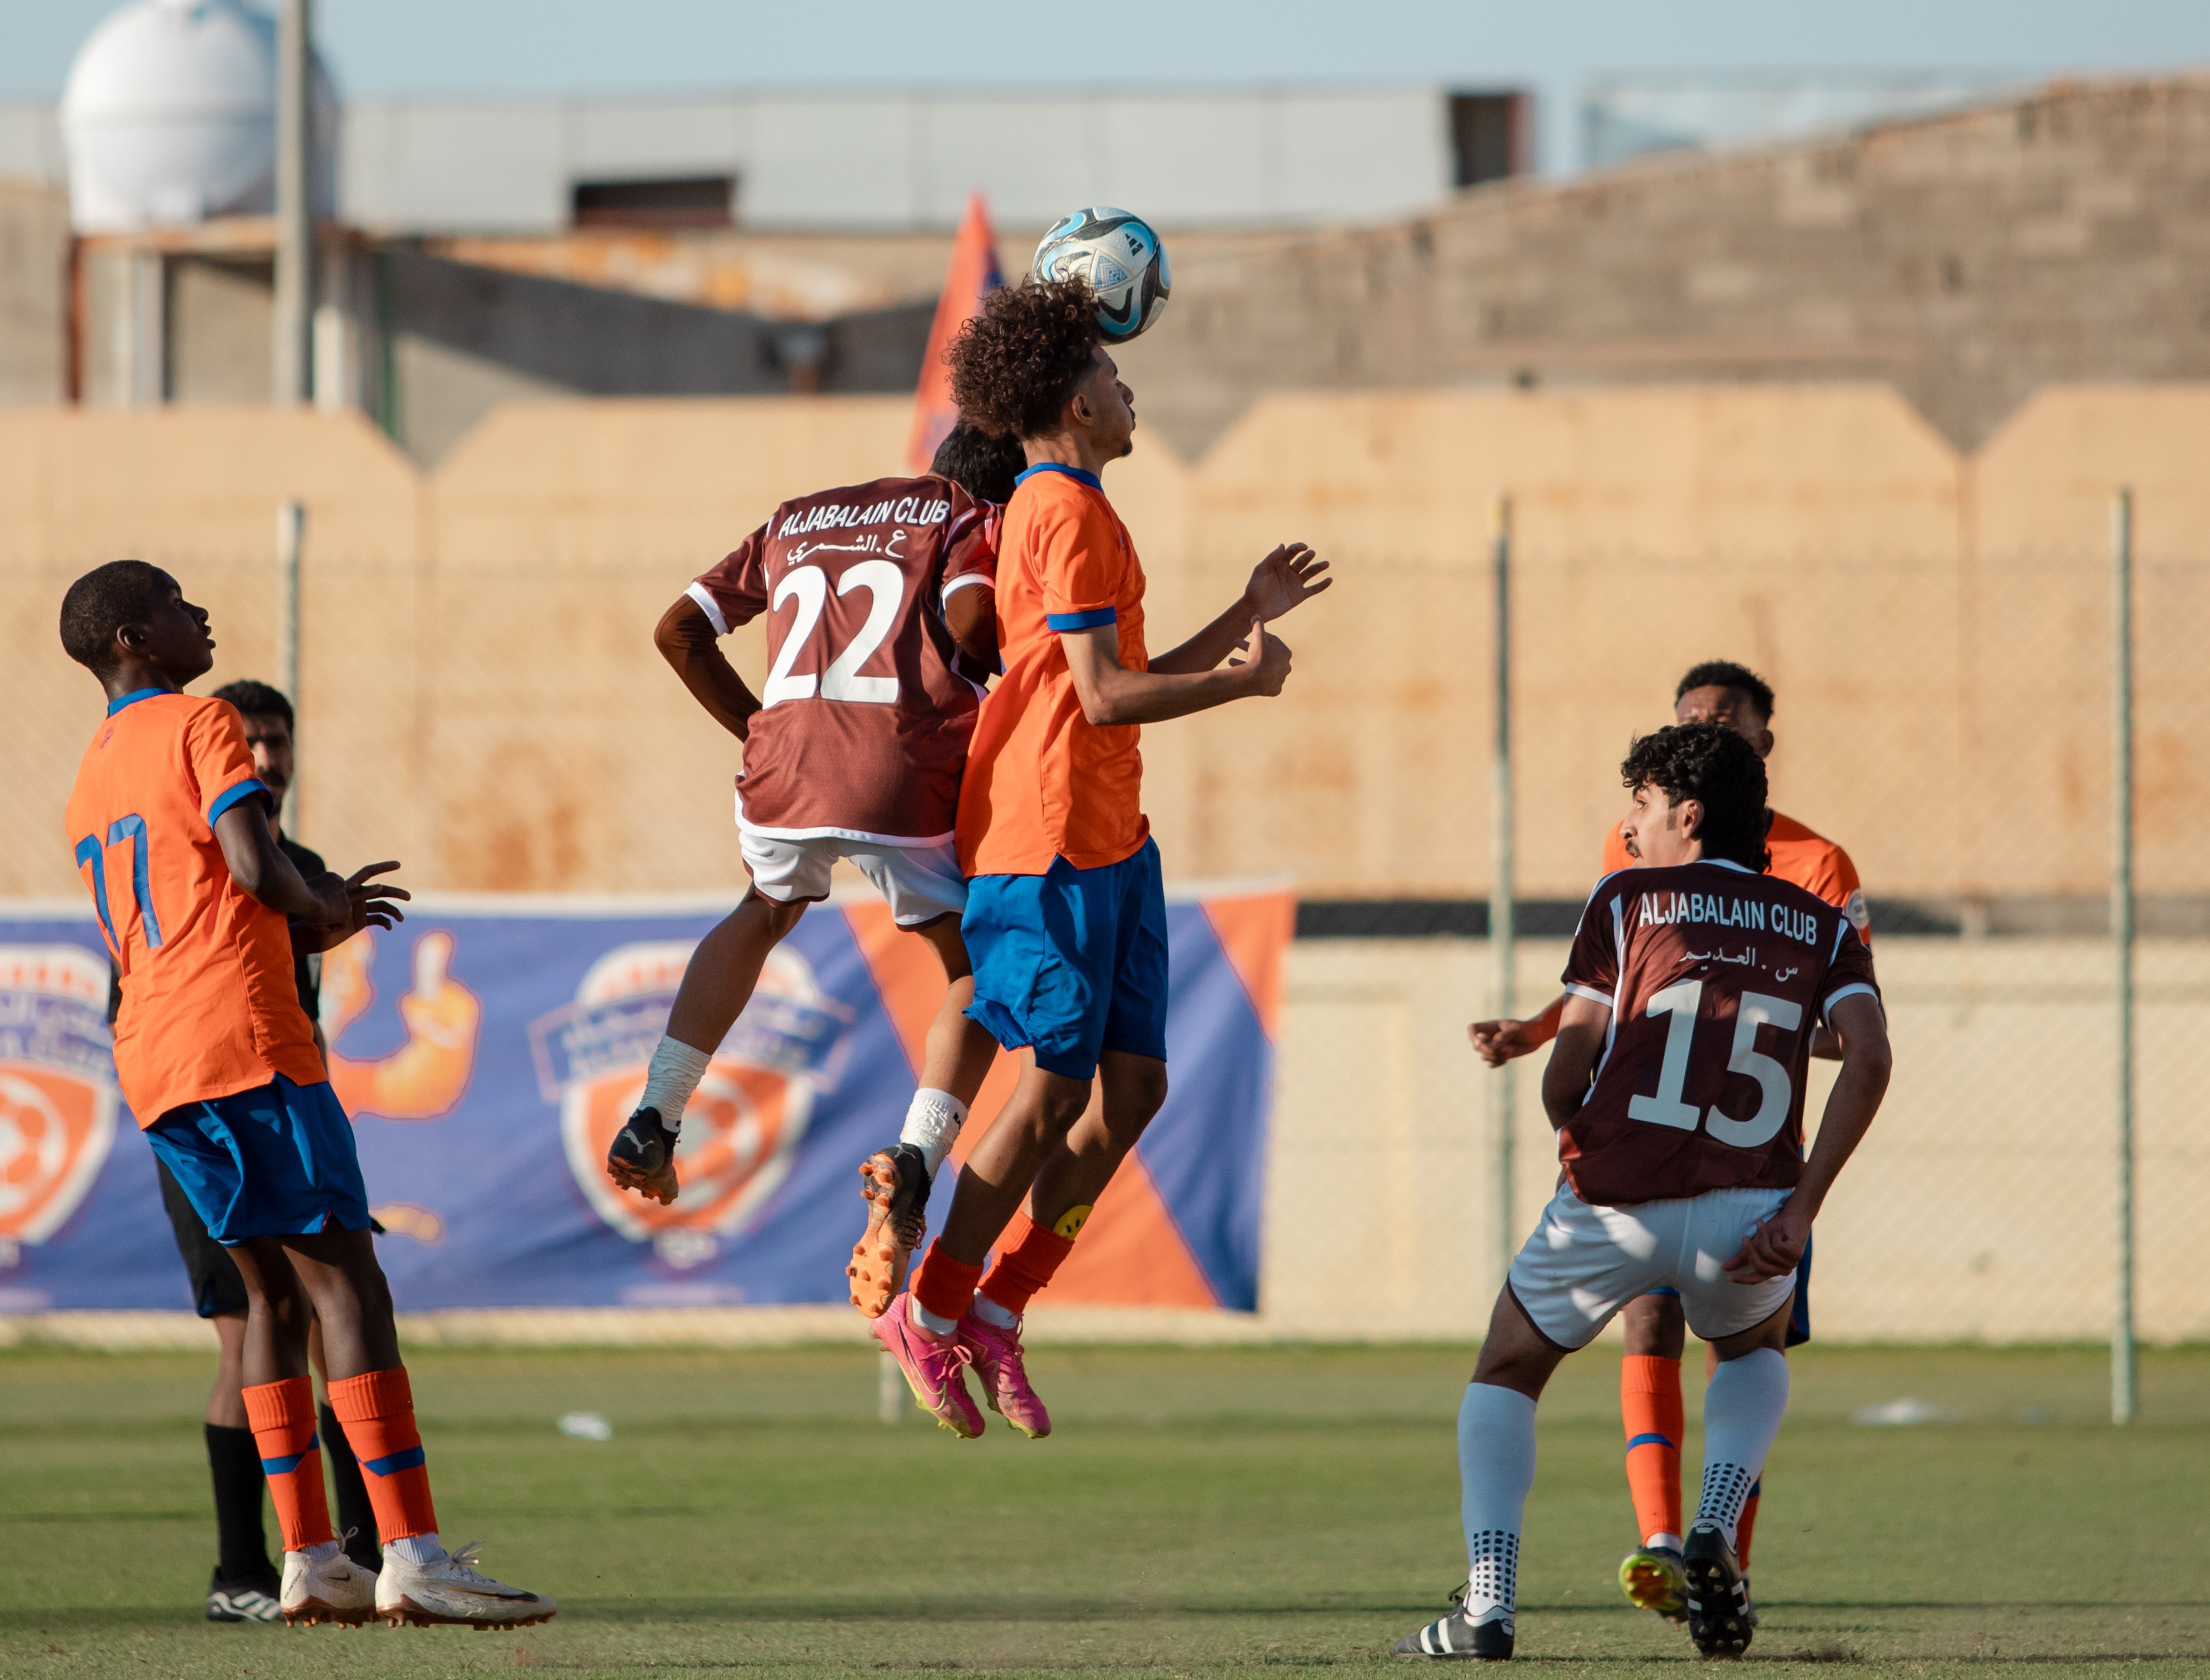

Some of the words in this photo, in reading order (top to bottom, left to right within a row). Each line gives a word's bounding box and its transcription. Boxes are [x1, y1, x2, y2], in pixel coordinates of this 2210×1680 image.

[778, 499, 896, 540] ALJABALAIN
[894, 497, 950, 525] CLUB
[763, 560, 904, 710] 22
[1639, 892, 1764, 930] ALJABALAIN
[1771, 904, 1817, 945] CLUB
[1628, 978, 1803, 1148] 15
